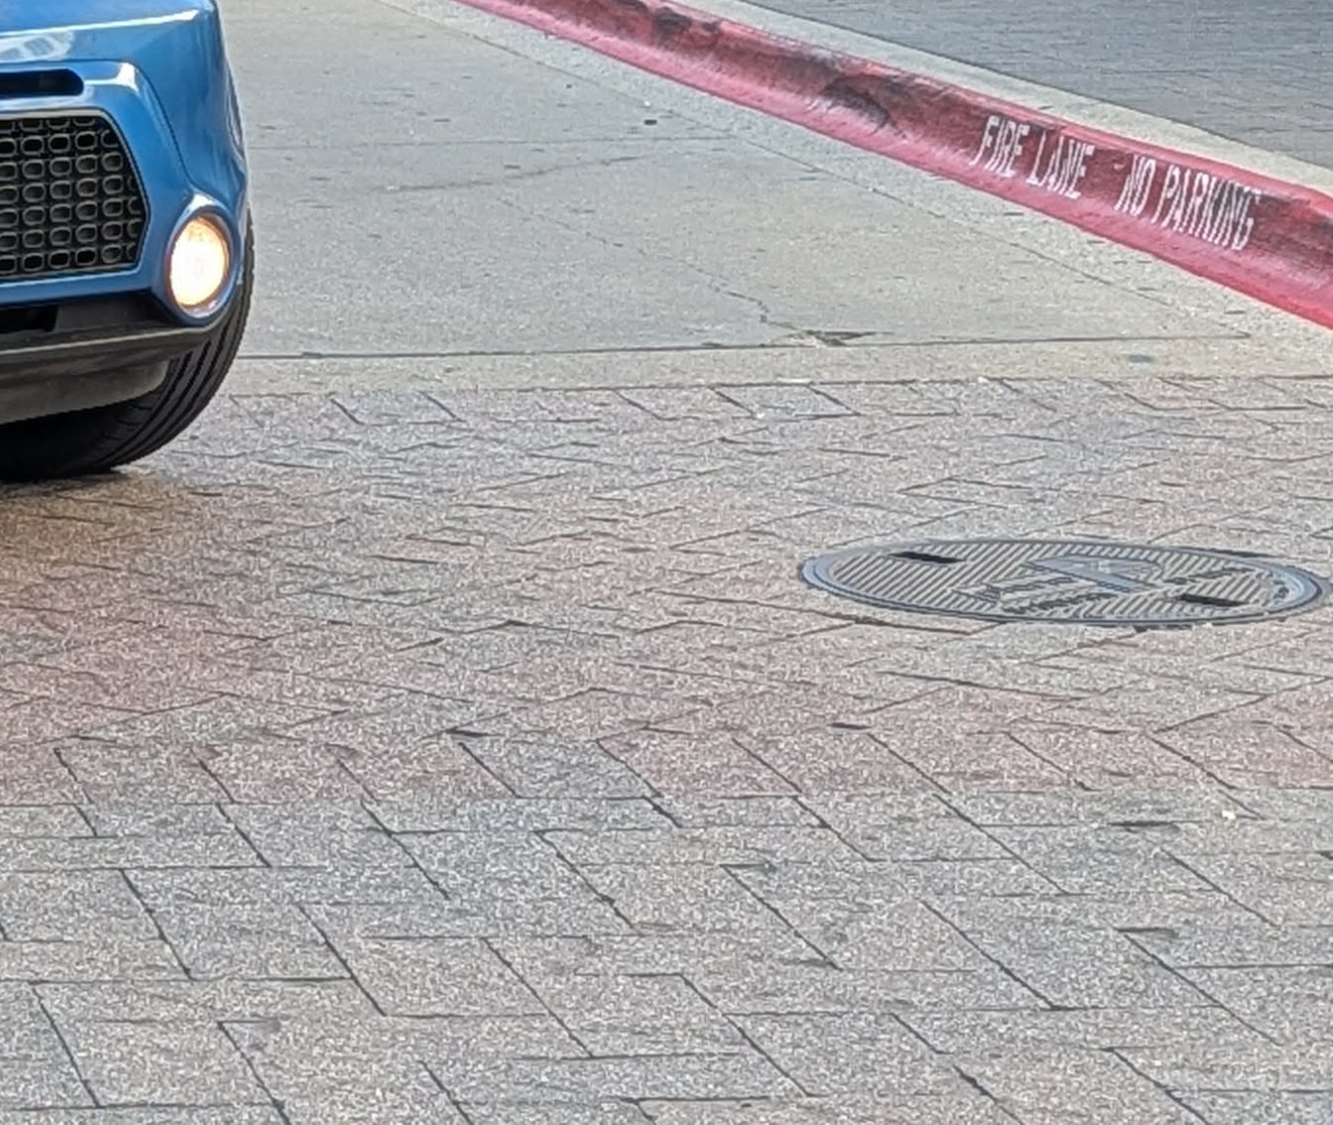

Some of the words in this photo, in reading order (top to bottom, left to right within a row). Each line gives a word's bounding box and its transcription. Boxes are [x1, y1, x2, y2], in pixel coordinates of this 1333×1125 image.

[969, 115, 1031, 178] FIRE
[1025, 129, 1096, 200] LANE
[1114, 154, 1157, 217] NO
[1151, 164, 1262, 251] PARKING
